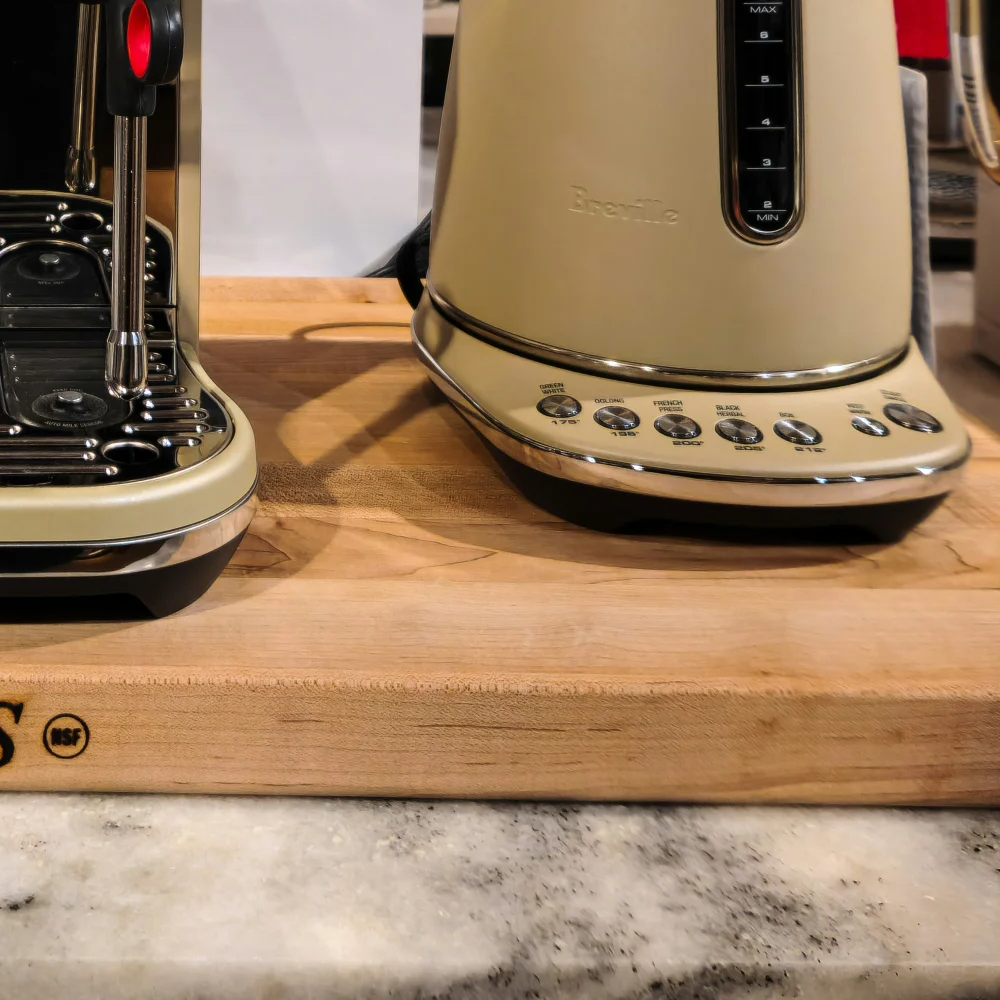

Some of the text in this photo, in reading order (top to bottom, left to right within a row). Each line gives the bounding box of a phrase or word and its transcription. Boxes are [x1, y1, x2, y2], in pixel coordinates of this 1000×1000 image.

[760, 75, 770, 83] 5
[761, 118, 770, 126] 4
[762, 158, 771, 166] 3
[568, 184, 679, 225] Breville
[763, 201, 772, 209] 2
[756, 213, 779, 221] MIN
[51, 728, 83, 746] NSF
